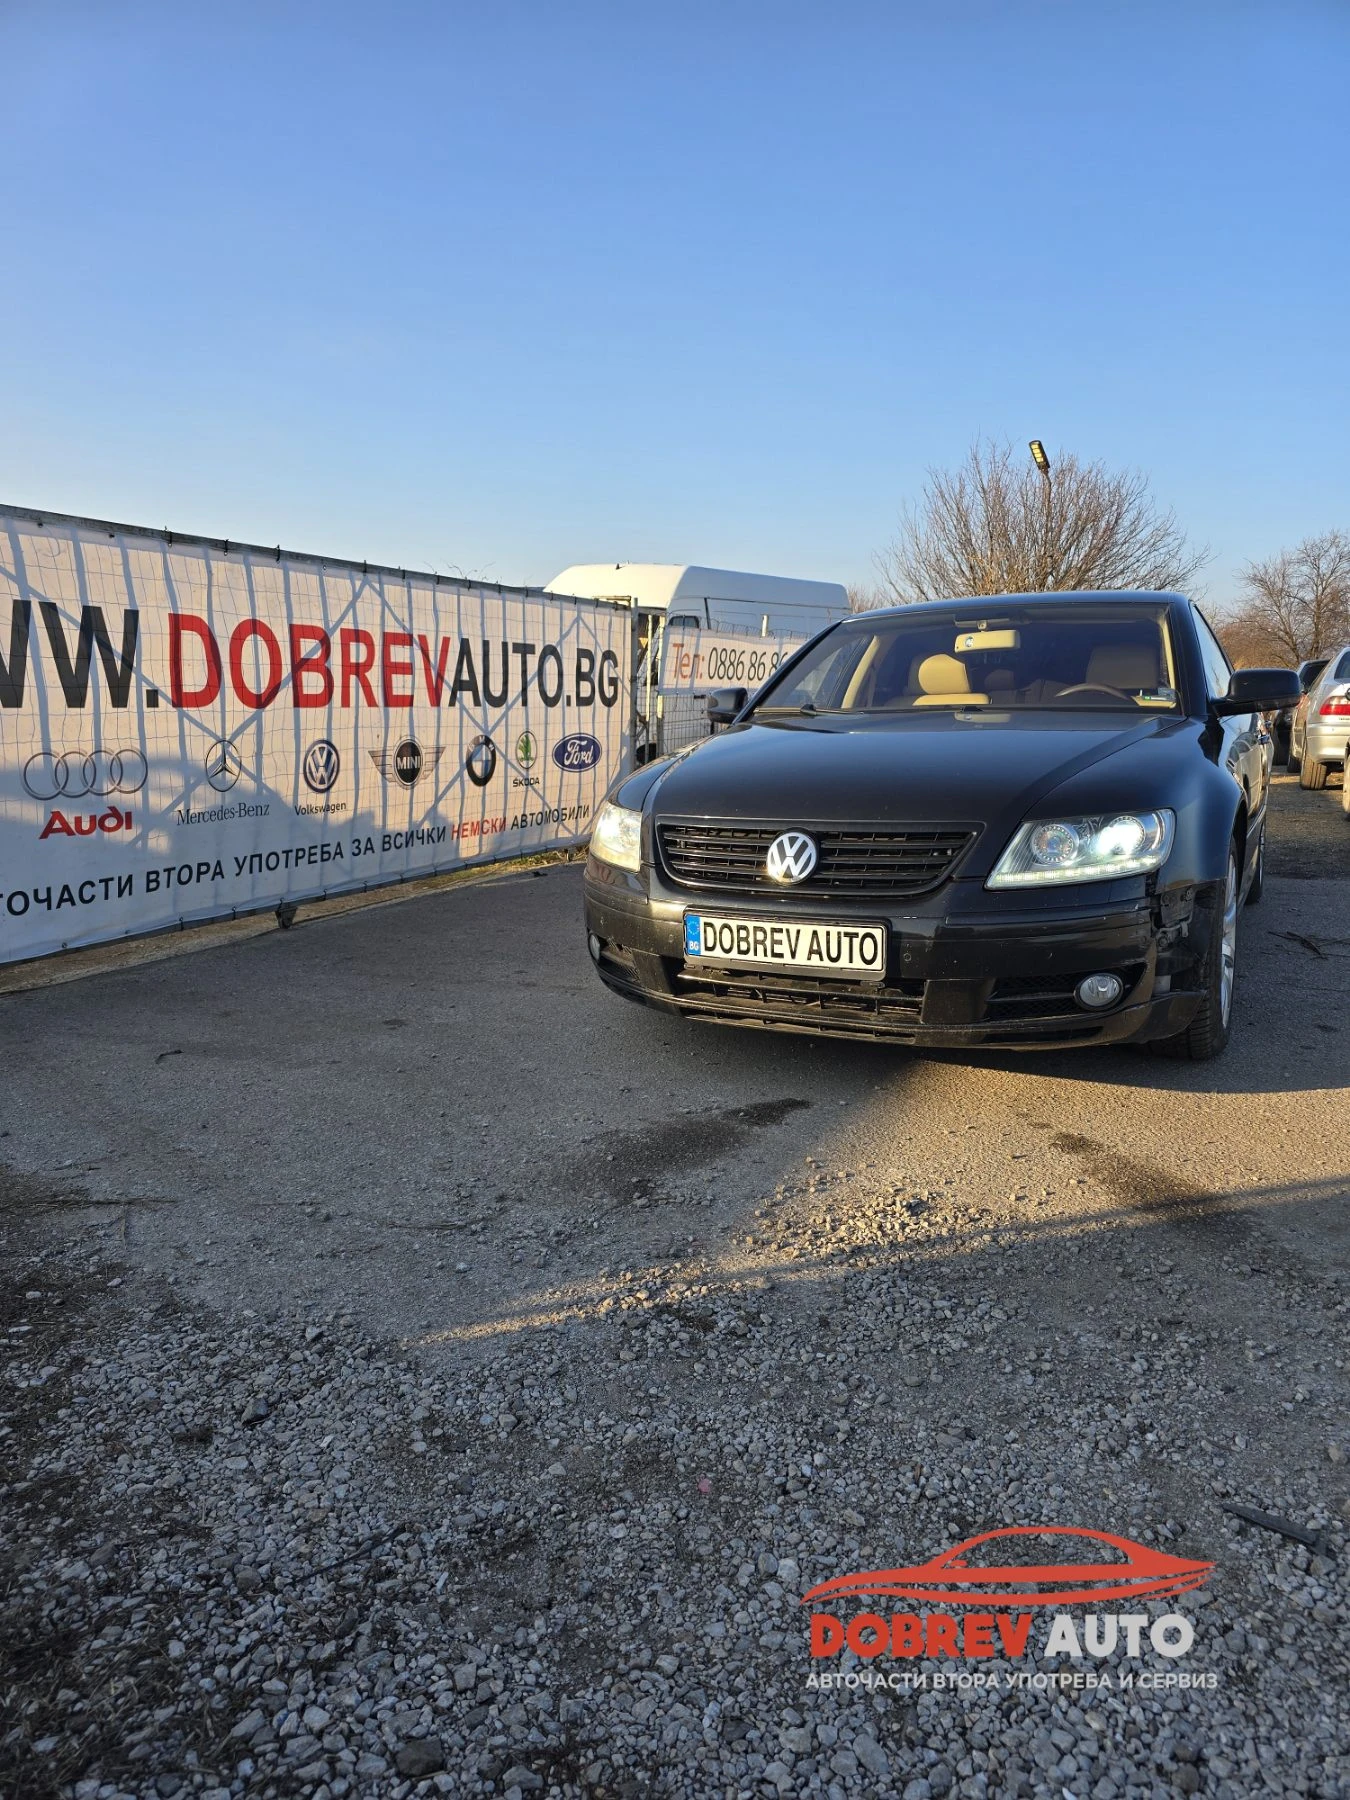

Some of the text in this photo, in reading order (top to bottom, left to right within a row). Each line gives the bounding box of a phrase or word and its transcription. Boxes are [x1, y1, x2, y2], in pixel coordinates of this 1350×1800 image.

[708, 647, 788, 681] 0886 86 8
[397, 755, 420, 770] MINI
[564, 739, 594, 766] Ford
[176, 803, 270, 826] Mercedes-Benz
[294, 800, 347, 816] Volkswagen
[39, 805, 133, 840] Audi
[0, 804, 590, 916] ОЧАСТИ ВТОРА УПОТРЕБА ЗА ВСИЧКИ НЕМСКИ АВТОМОБИЛИ
[688, 941, 699, 951] BG
[703, 921, 879, 966] DOBREV AUTO
